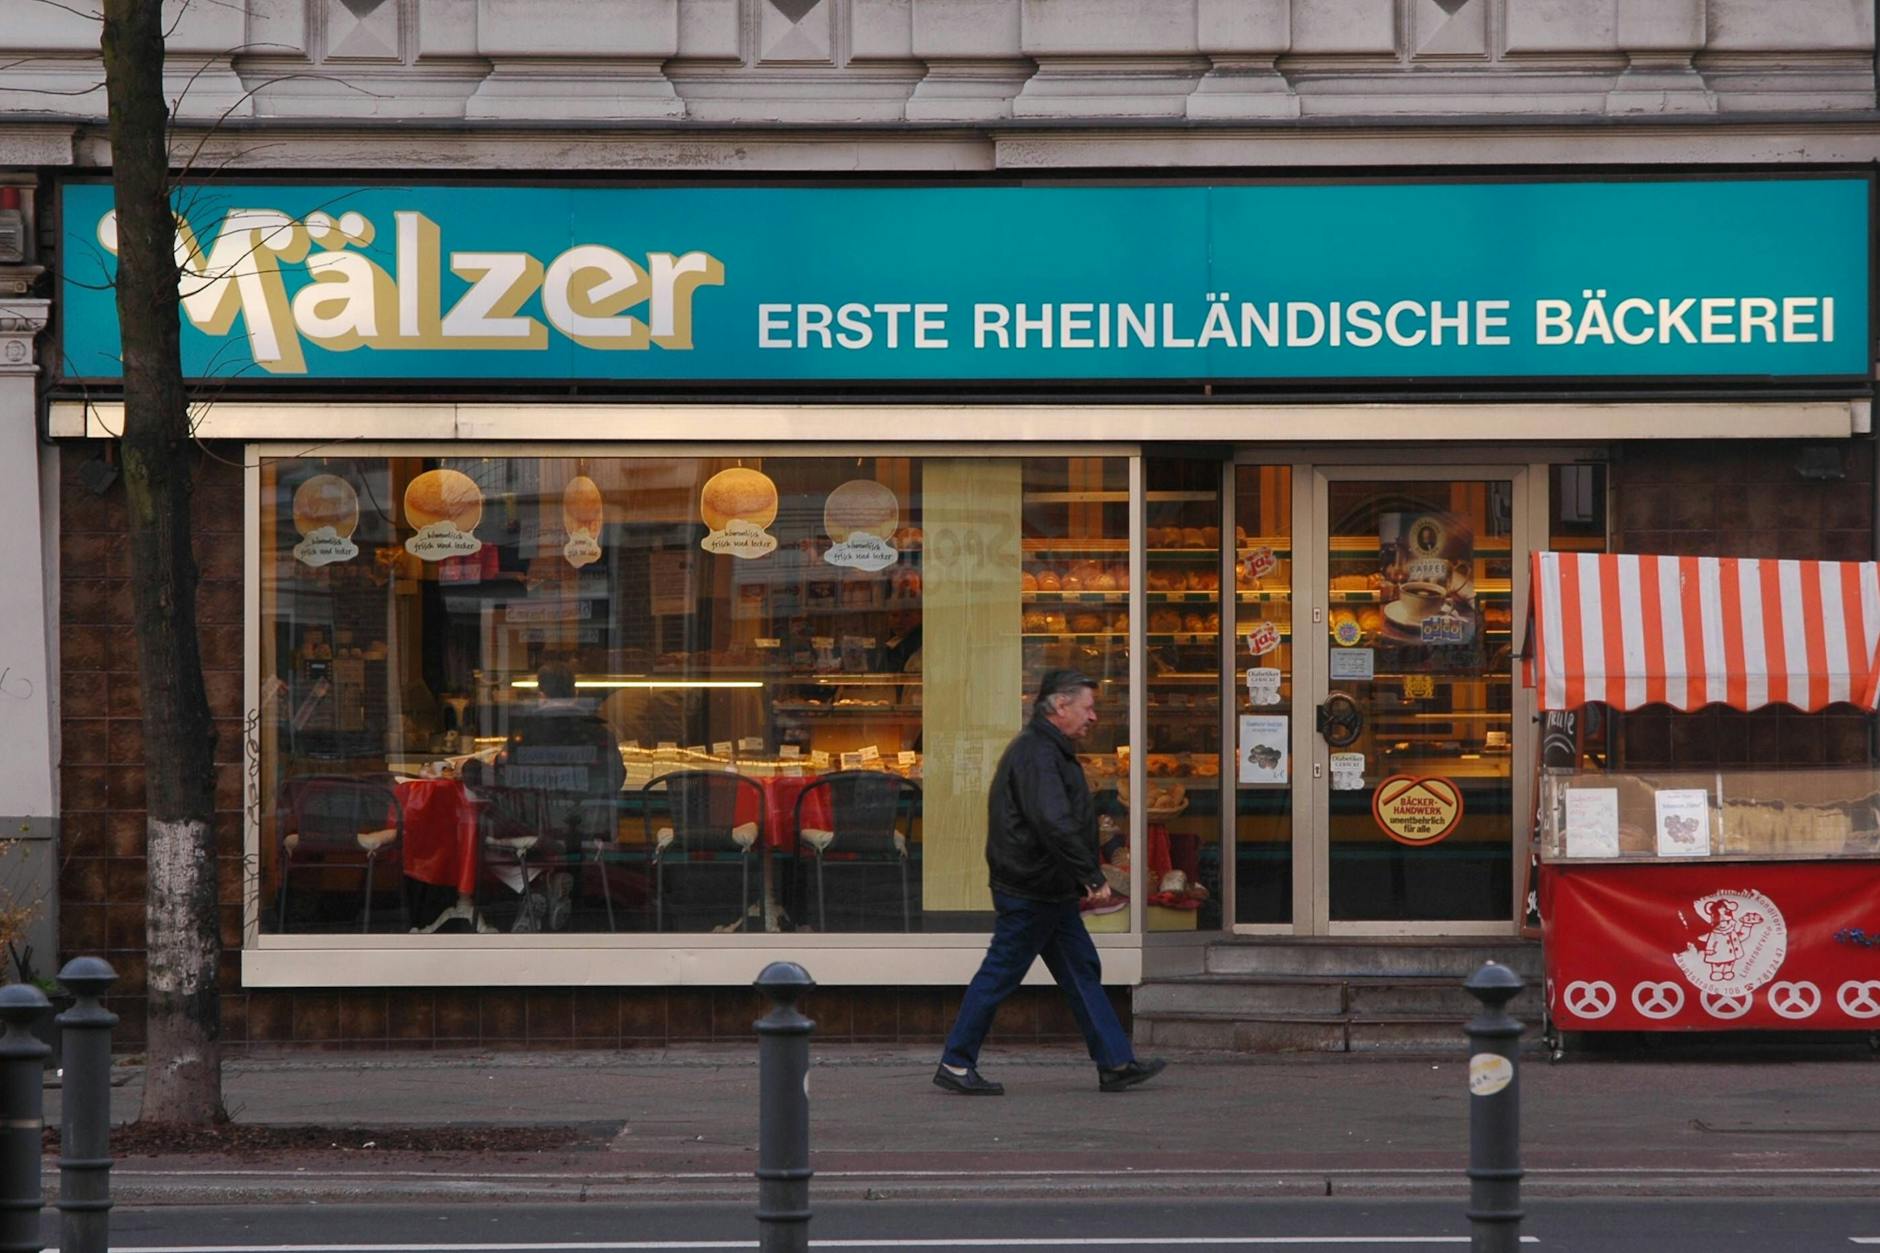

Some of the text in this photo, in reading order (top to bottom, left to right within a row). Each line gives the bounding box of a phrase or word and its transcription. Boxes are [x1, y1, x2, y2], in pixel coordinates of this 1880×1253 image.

[98, 208, 725, 373] Mälzer
[758, 289, 1834, 349] ERSTE RHEINLÄNDISCHE BÄCKEREI
[1400, 796, 1438, 806] BÄCKER-
[1393, 806, 1442, 815] HANDWERK
[1390, 816, 1446, 825] unentbehrlich
[1404, 825, 1431, 833] für alle
